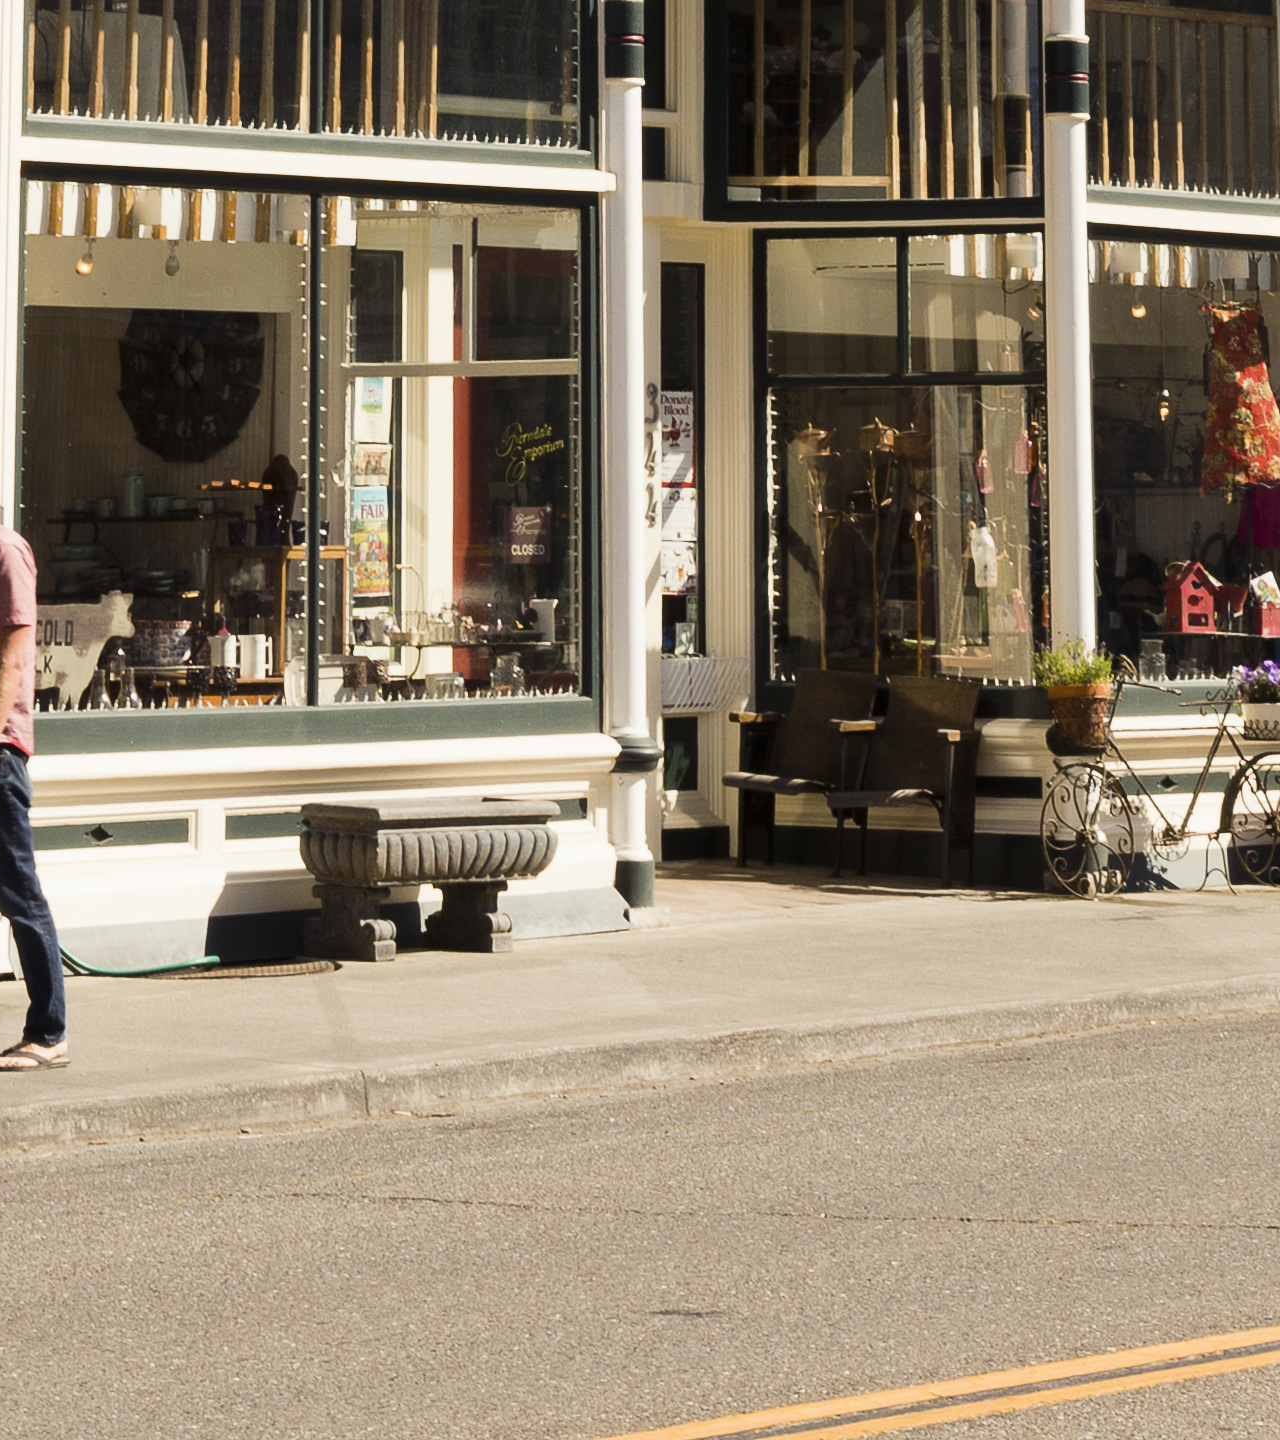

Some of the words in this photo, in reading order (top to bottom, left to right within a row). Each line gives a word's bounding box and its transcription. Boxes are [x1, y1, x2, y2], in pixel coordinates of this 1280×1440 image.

[660, 394, 693, 405] Donate
[663, 405, 689, 416] Blood
[505, 439, 565, 486] Emporium
[360, 504, 385, 519] FAIR
[511, 544, 546, 556] CLOSED
